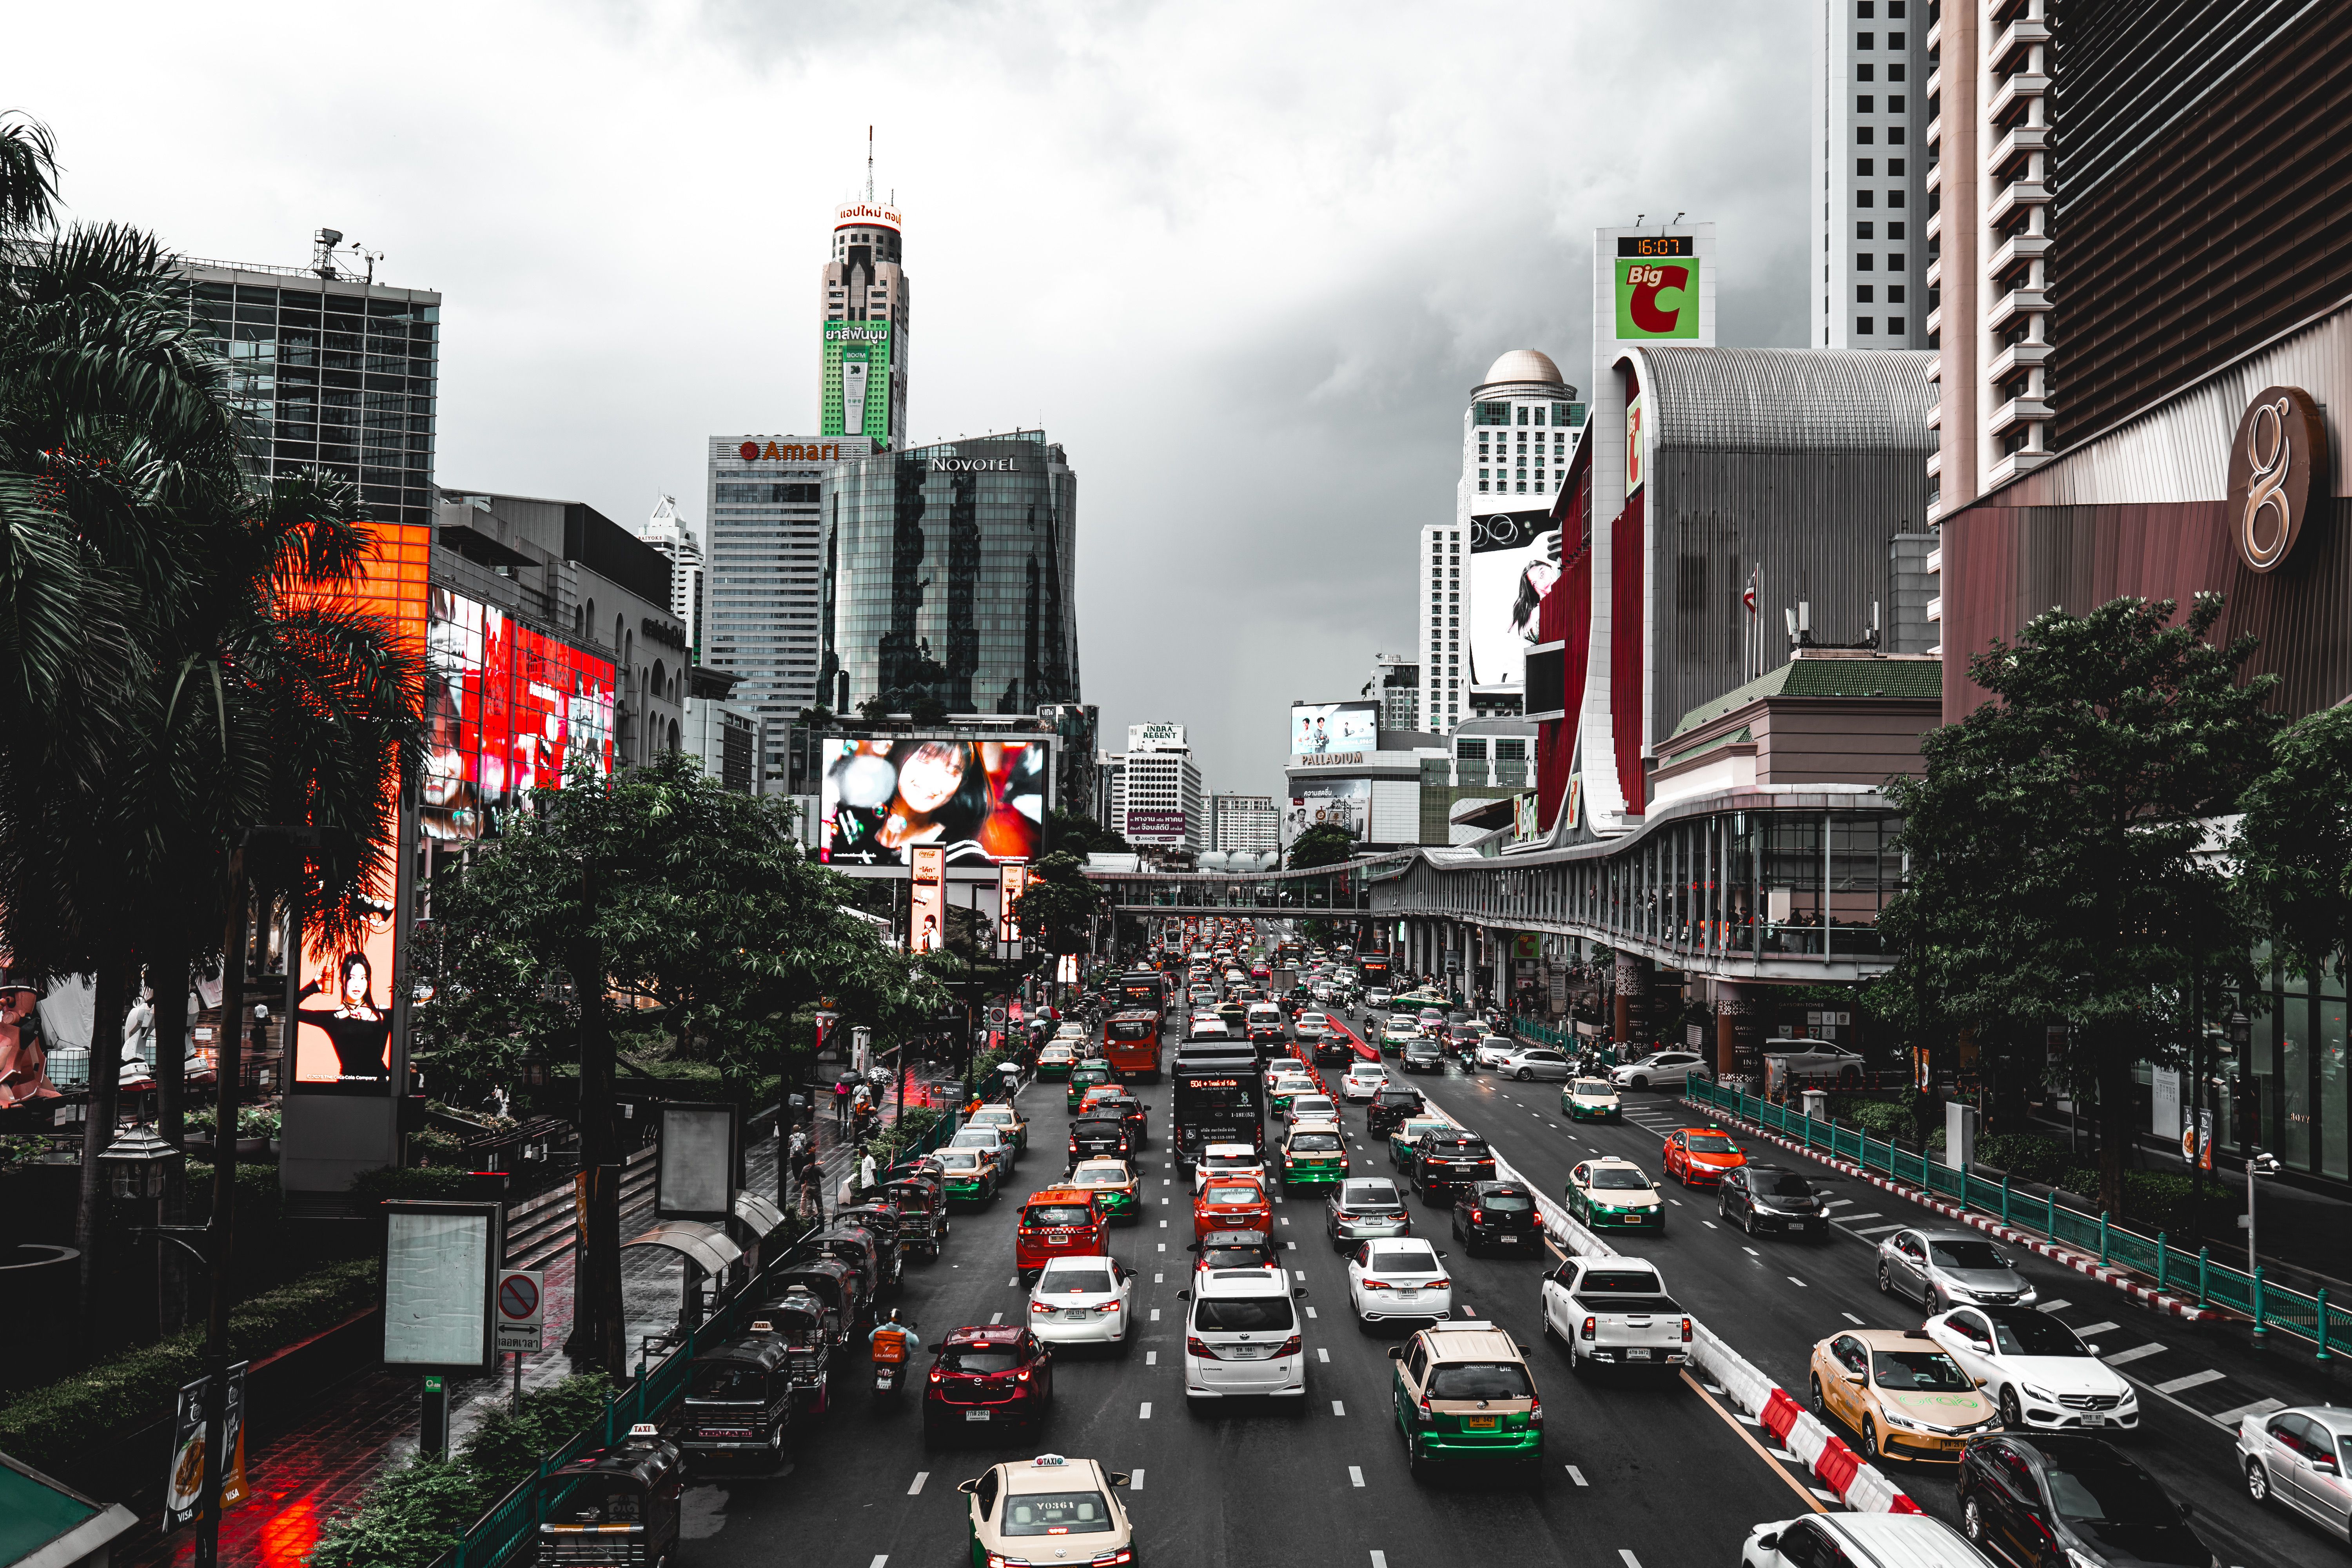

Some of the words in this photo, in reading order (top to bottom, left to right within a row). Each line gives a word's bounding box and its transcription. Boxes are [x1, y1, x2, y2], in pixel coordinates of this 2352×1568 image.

[840, 205, 881, 218] แอปใหม่
[1638, 239, 1679, 254] 16:07
[1628, 265, 1663, 287] Big
[1630, 265, 1689, 333] C
[826, 326, 887, 344] ยาสีฟันบูม
[762, 441, 839, 461] Amari
[932, 457, 1020, 471] NOVOTEL
[1301, 752, 1363, 765] PALLADIUM
[1303, 786, 1332, 797] ความสดชื่น
[1898, 1394, 1979, 1409] Grab
[225, 1488, 240, 1501] VISA
[1036, 1500, 1074, 1510] Y0361
[176, 1509, 193, 1523] VISA
